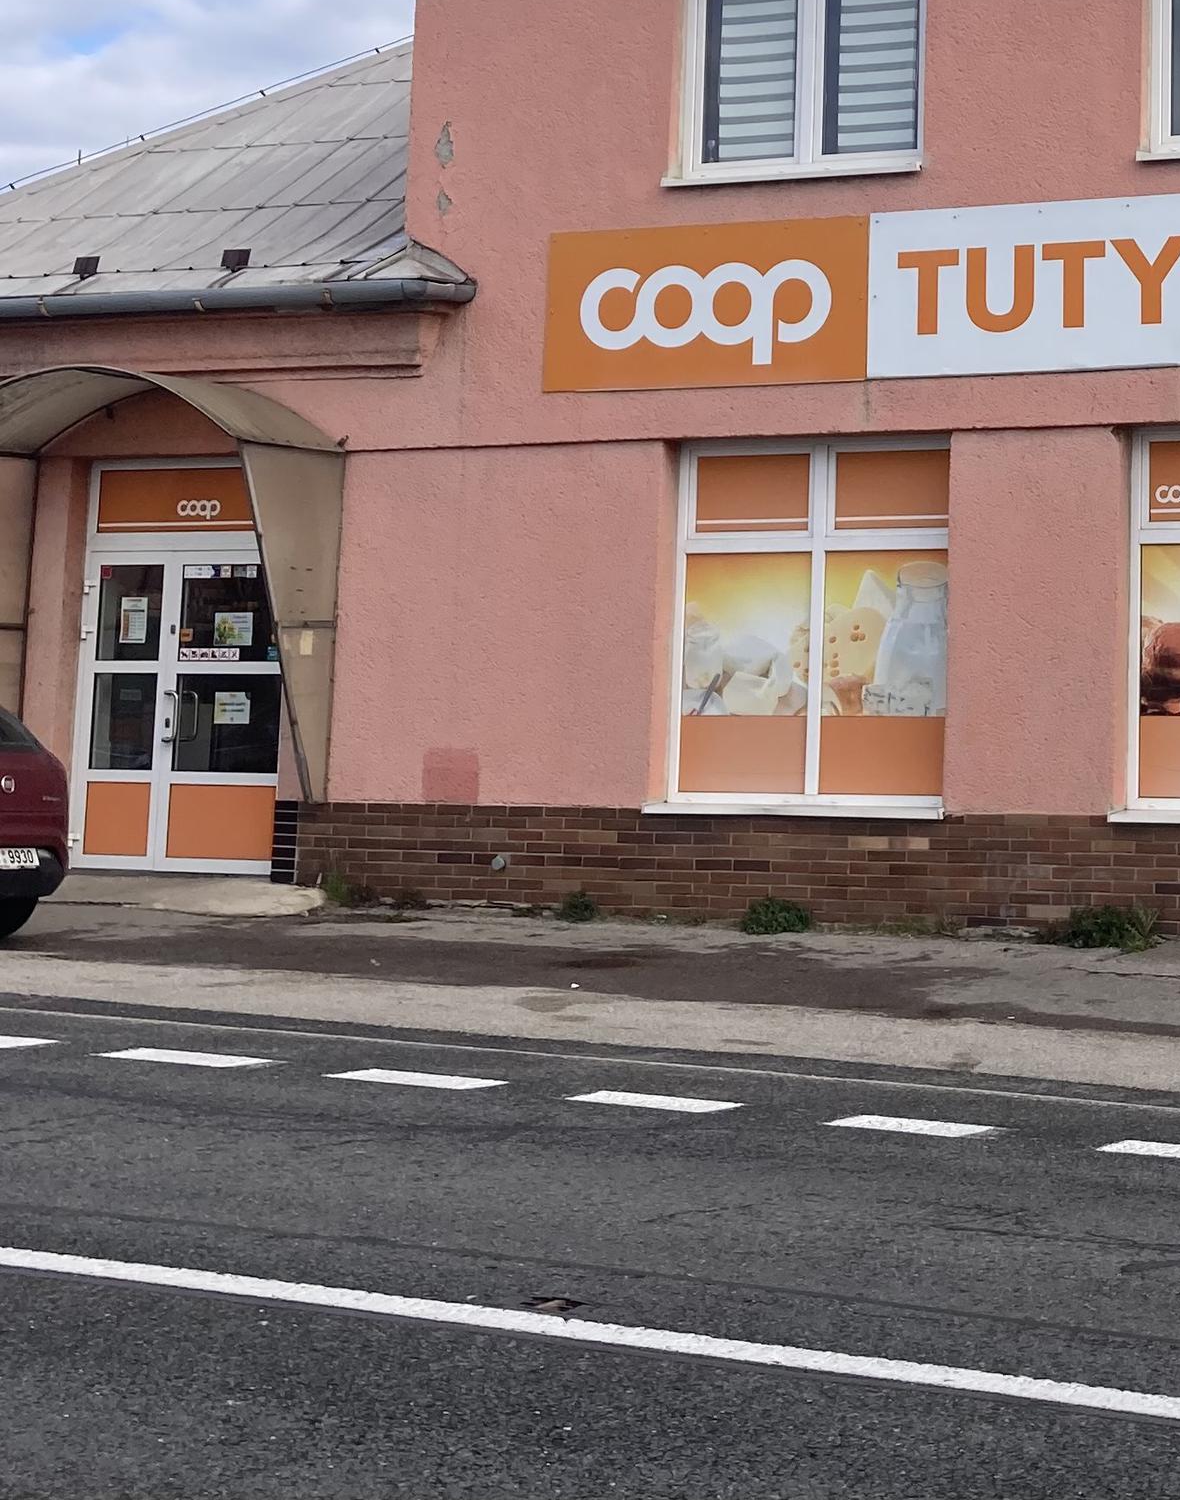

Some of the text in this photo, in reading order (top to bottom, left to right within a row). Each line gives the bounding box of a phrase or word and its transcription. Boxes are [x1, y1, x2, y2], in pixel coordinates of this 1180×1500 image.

[580, 259, 832, 365] coop
[177, 499, 221, 520] coop
[7, 849, 34, 863] 9930
